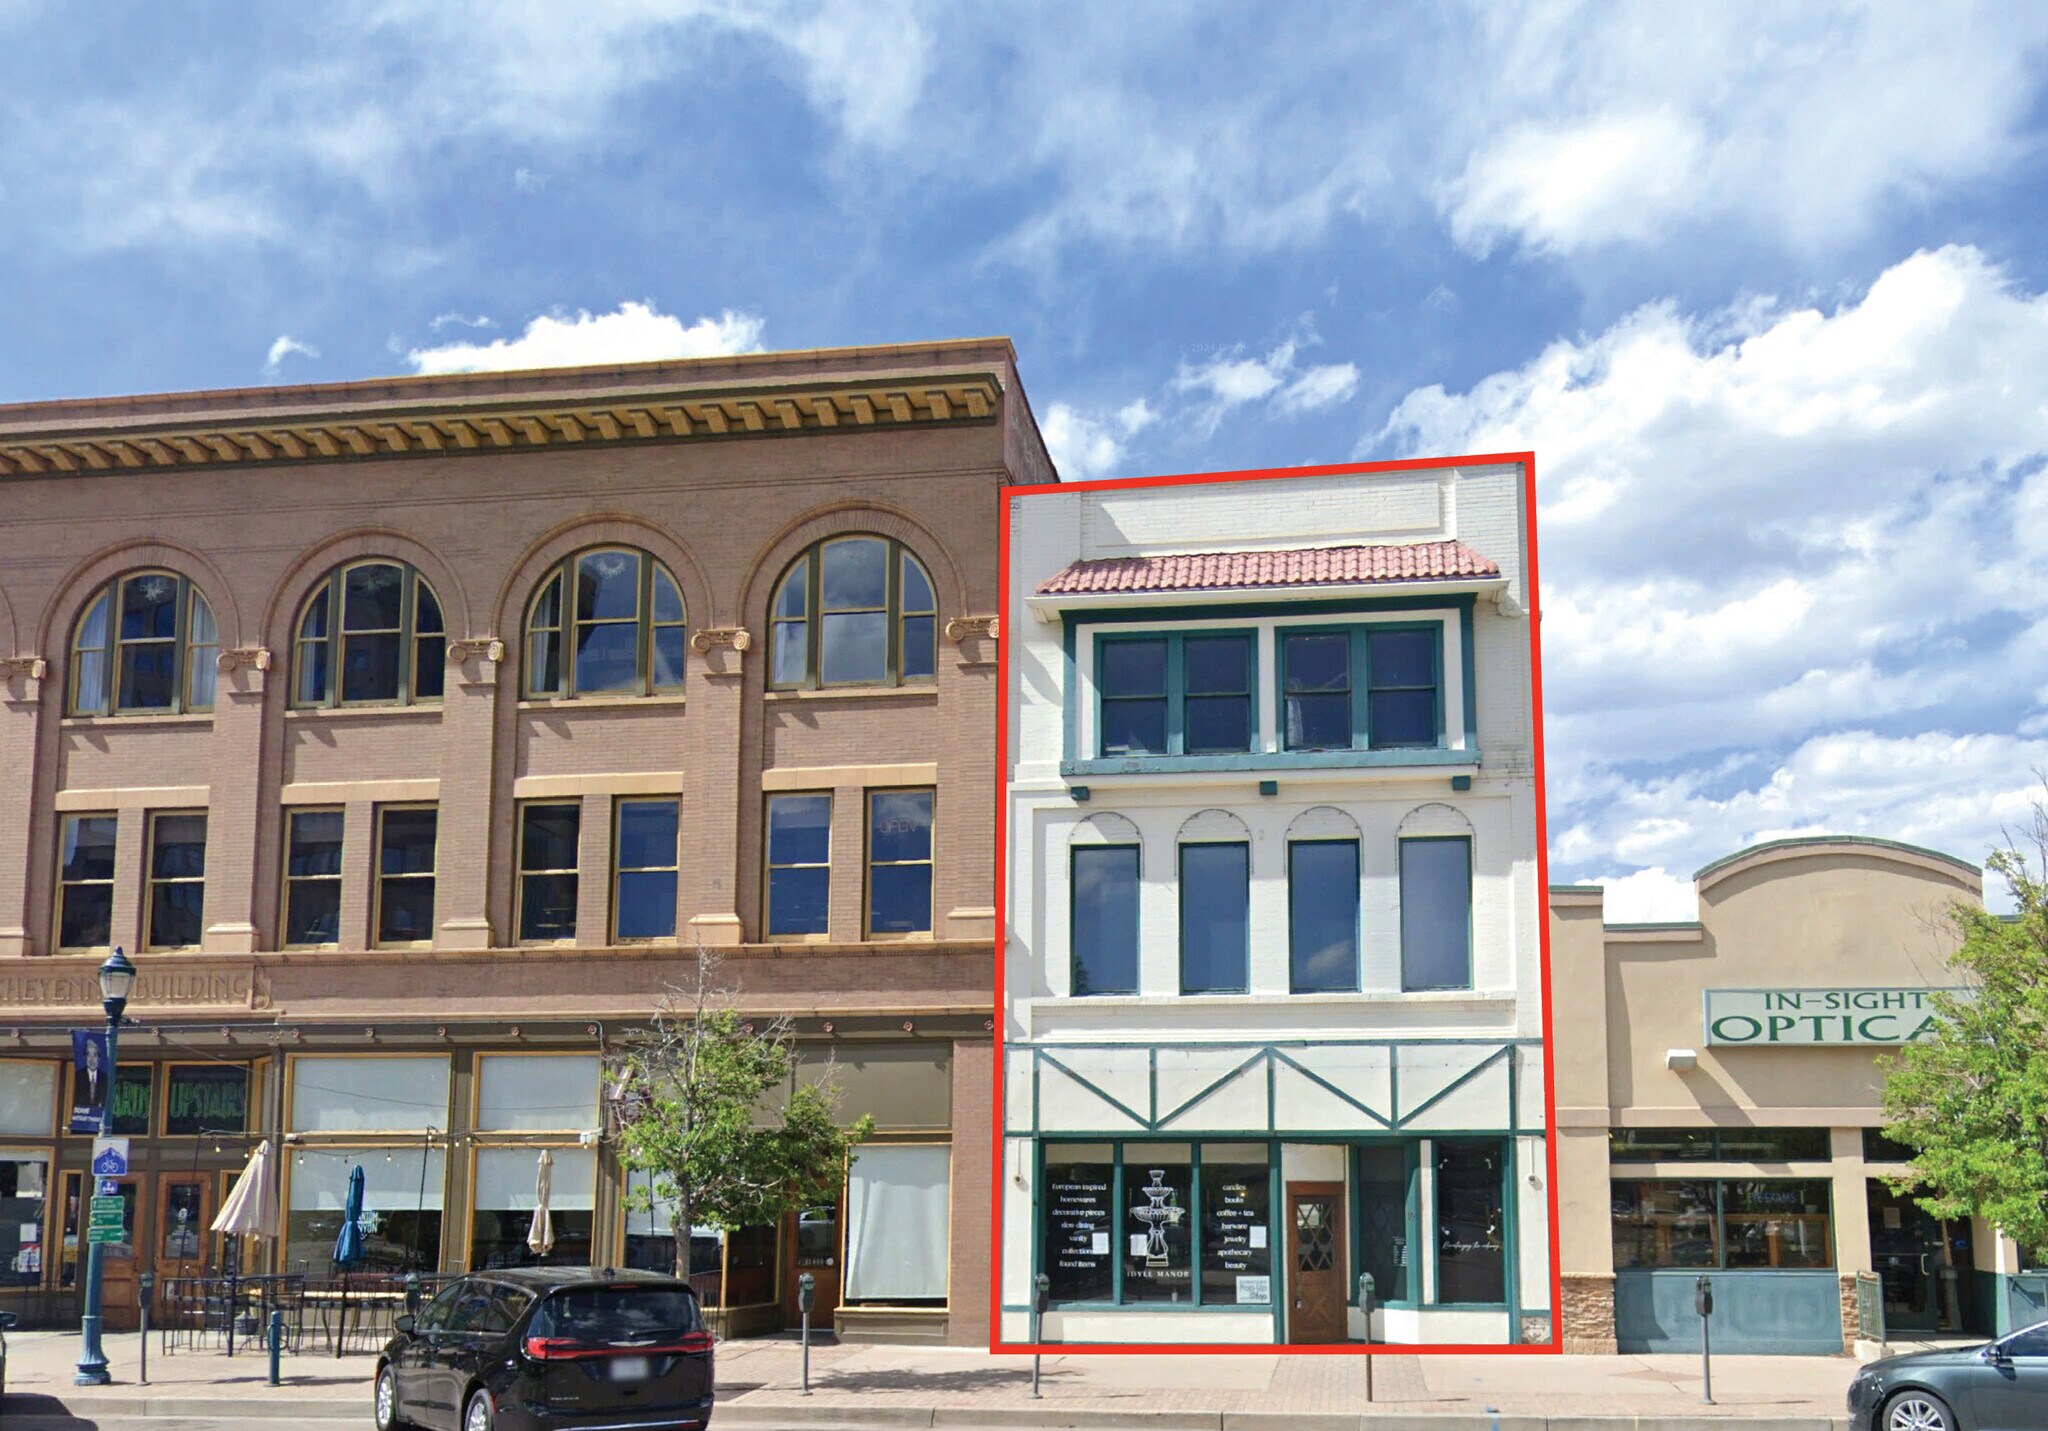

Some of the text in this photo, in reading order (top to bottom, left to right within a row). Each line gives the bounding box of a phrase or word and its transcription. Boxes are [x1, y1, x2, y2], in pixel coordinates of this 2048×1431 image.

[879, 817, 918, 834] OPEN
[0, 975, 247, 1001] HEYENN BUILDING
[1711, 1015, 1938, 1041] OPTICA
[170, 1082, 247, 1118] UPSTAIRS
[1052, 1183, 1107, 1192] European inspired
[1222, 1183, 1246, 1191] candles
[1052, 1208, 1106, 1218] decorative pieces
[1216, 1209, 1238, 1217] coffee
[1061, 1221, 1095, 1231] slow dining
[1221, 1222, 1249, 1231] barware
[1069, 1235, 1087, 1243] vanity
[1223, 1235, 1248, 1245] jewelry
[1217, 1248, 1252, 1257] apothecary
[1059, 1260, 1078, 1268] found
[1225, 1261, 1247, 1270] beauty
[1126, 1270, 1190, 1278] IDYLL MANOR
